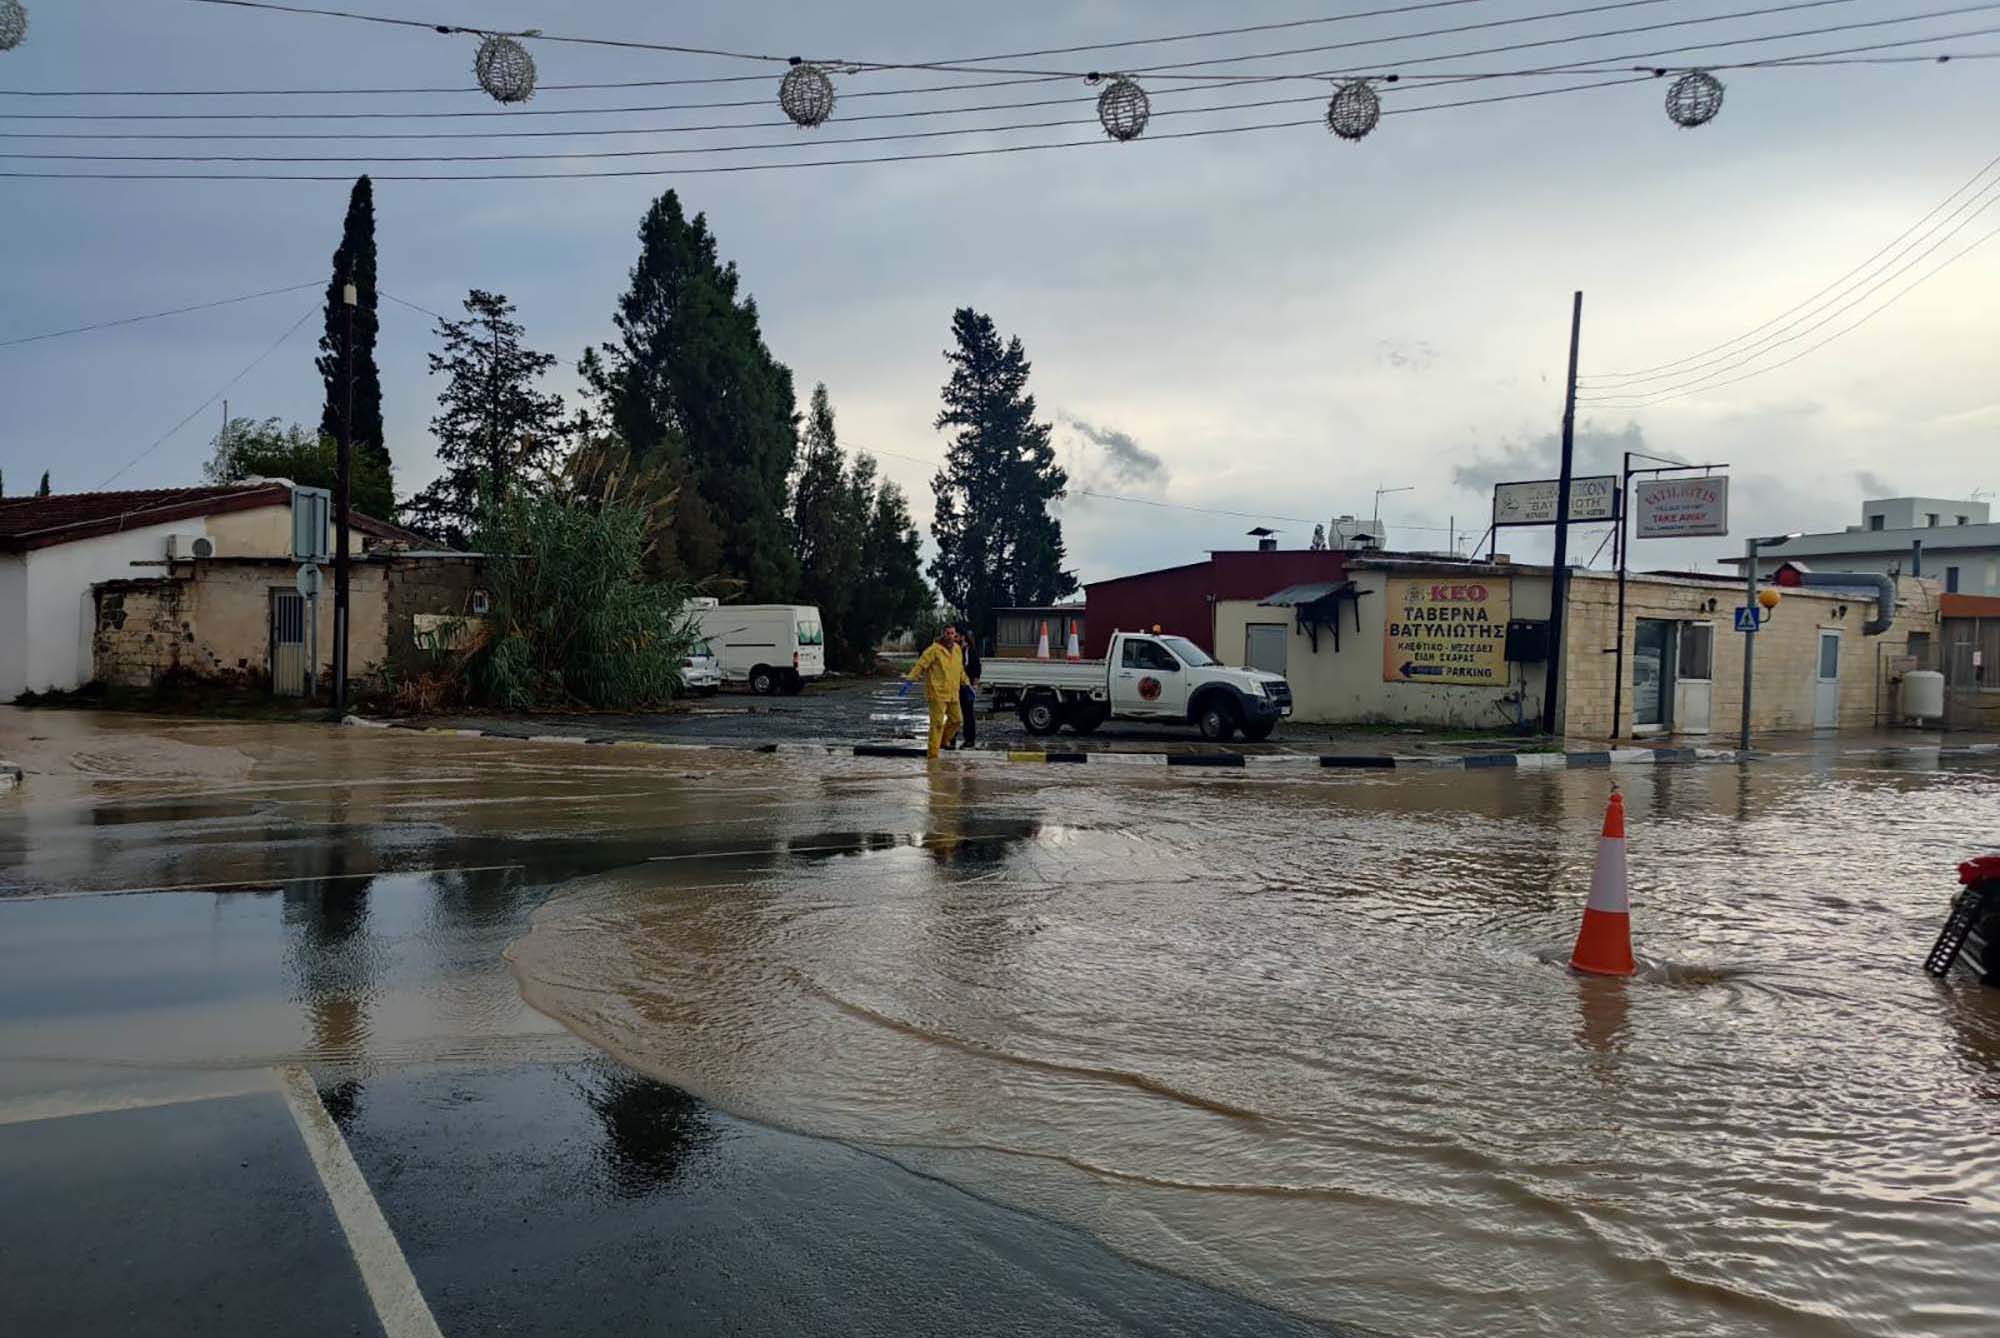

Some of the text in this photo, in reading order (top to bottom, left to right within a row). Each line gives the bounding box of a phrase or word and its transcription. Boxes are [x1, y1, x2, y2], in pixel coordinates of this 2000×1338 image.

[1652, 512, 1708, 523] TAKE AWAY
[1404, 607, 1488, 621] ΤΑΒΕΡΝΑ
[1390, 624, 1504, 638] ΒΑΤΥΛΙΩΤΗΣ
[1398, 642, 1443, 651] ΚΛΕΦΤΙΚΟ
[1414, 653, 1434, 661] ΕΙΔΗ
[1446, 667, 1492, 678] PARKING
